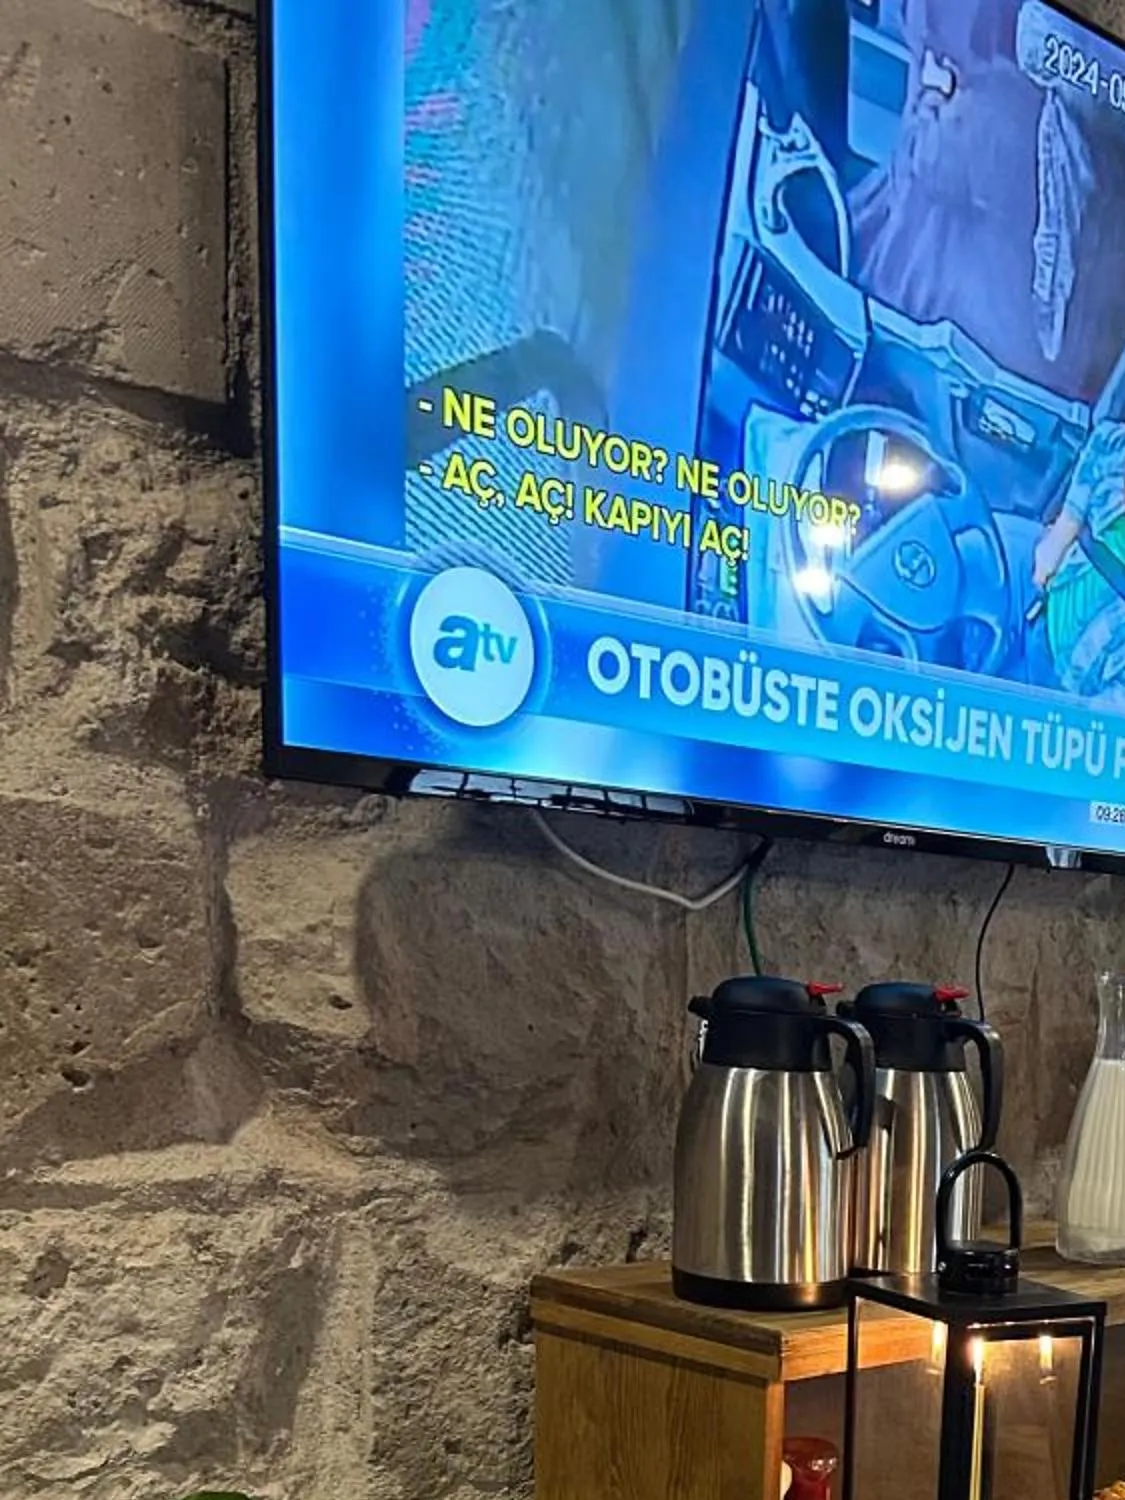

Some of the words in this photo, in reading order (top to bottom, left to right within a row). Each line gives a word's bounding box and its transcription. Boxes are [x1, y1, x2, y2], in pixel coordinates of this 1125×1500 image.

[443, 387, 495, 438] NE
[507, 408, 669, 483] OLUYOR?
[677, 455, 718, 498] NE
[728, 472, 860, 534] OLUYOR?
[443, 453, 504, 506] AÇ,
[516, 473, 573, 523] AÇ!
[586, 488, 690, 548] KAPIYI
[700, 520, 748, 564] AÇ!
[433, 614, 518, 673] atv
[586, 636, 840, 734] OTOBÜSTE
[848, 687, 1014, 760] OKSİJEN
[1021, 713, 1104, 777] TÜPÜ
